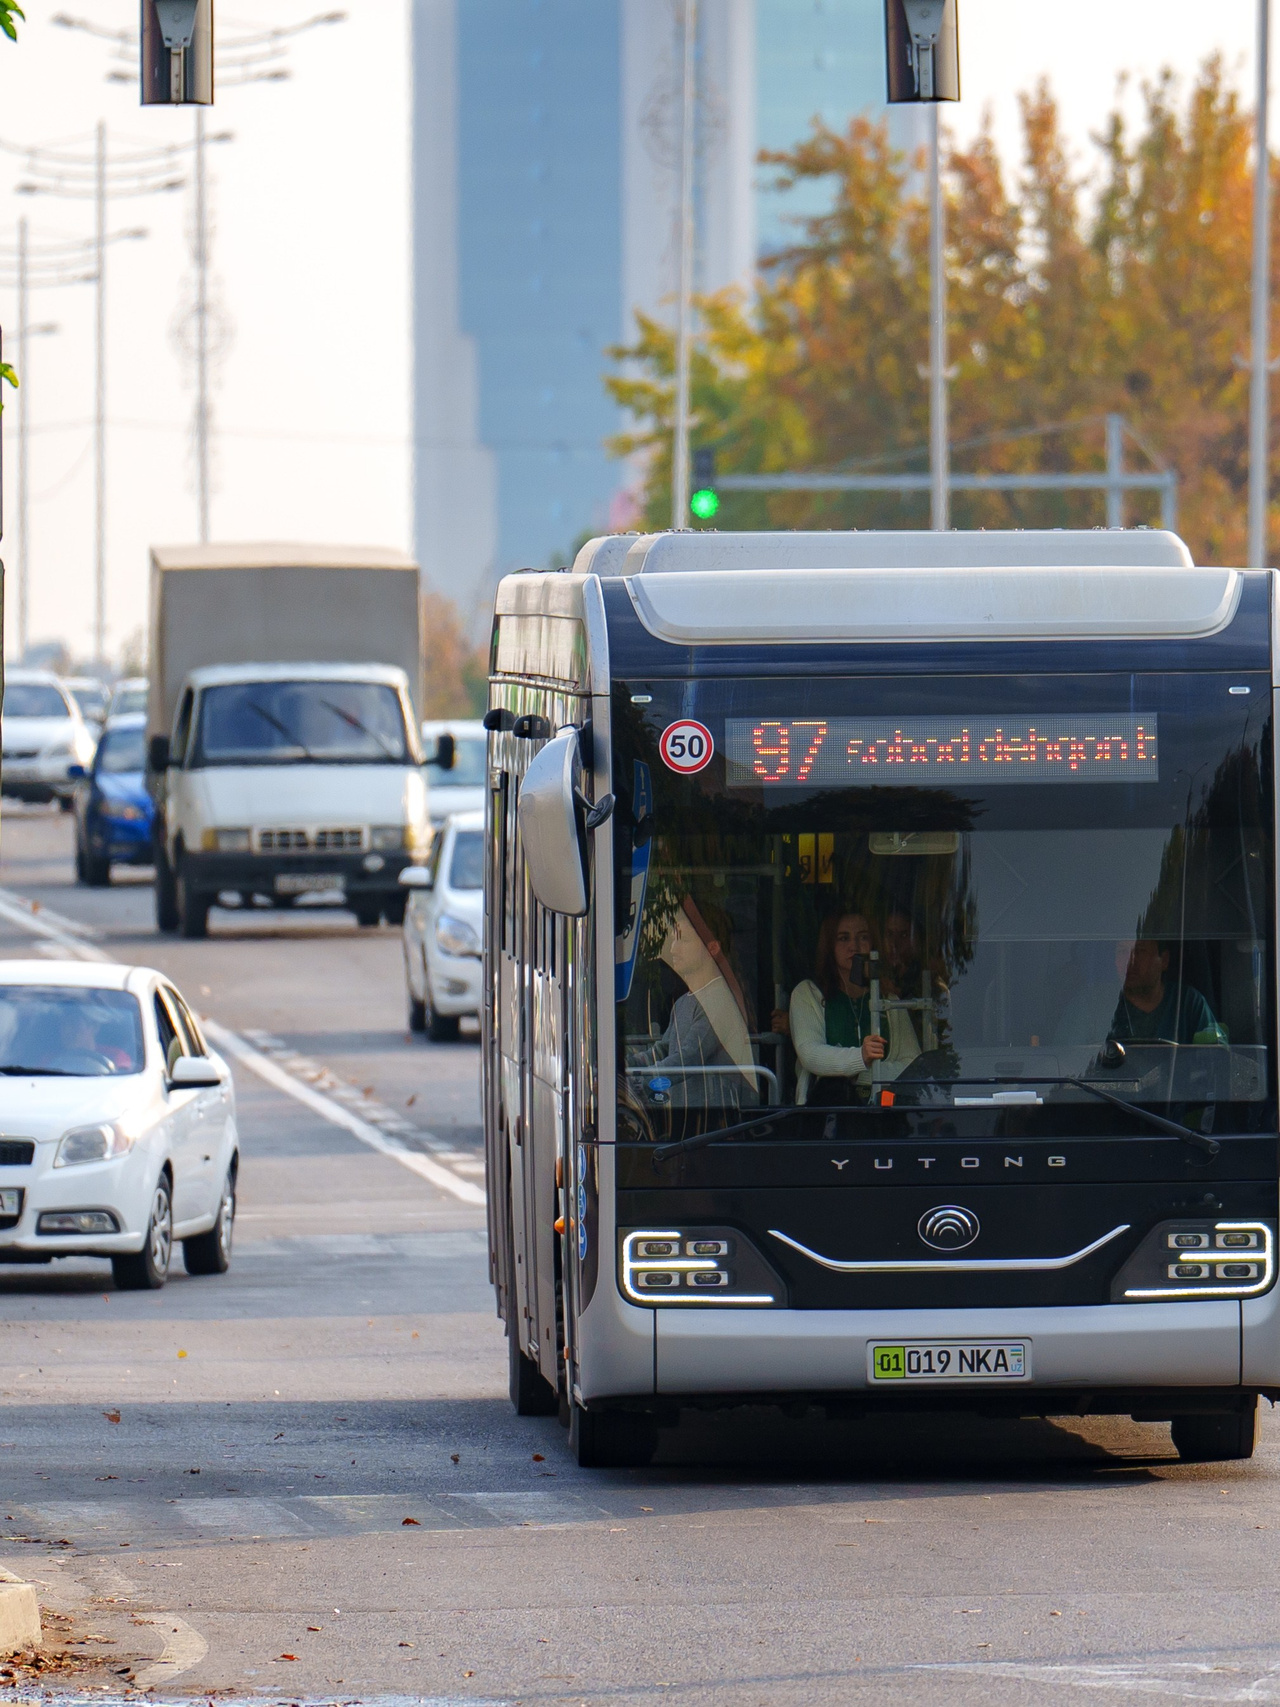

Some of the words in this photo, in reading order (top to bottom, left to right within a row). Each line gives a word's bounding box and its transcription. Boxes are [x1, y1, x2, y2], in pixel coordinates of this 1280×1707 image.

[669, 734, 704, 759] 50
[753, 722, 826, 780] 97
[831, 1155, 1066, 1171] YUTONG
[880, 1353, 902, 1372] 01
[907, 1350, 951, 1374] 019
[958, 1349, 1009, 1373] NKA
[1011, 1363, 1022, 1372] UZ
